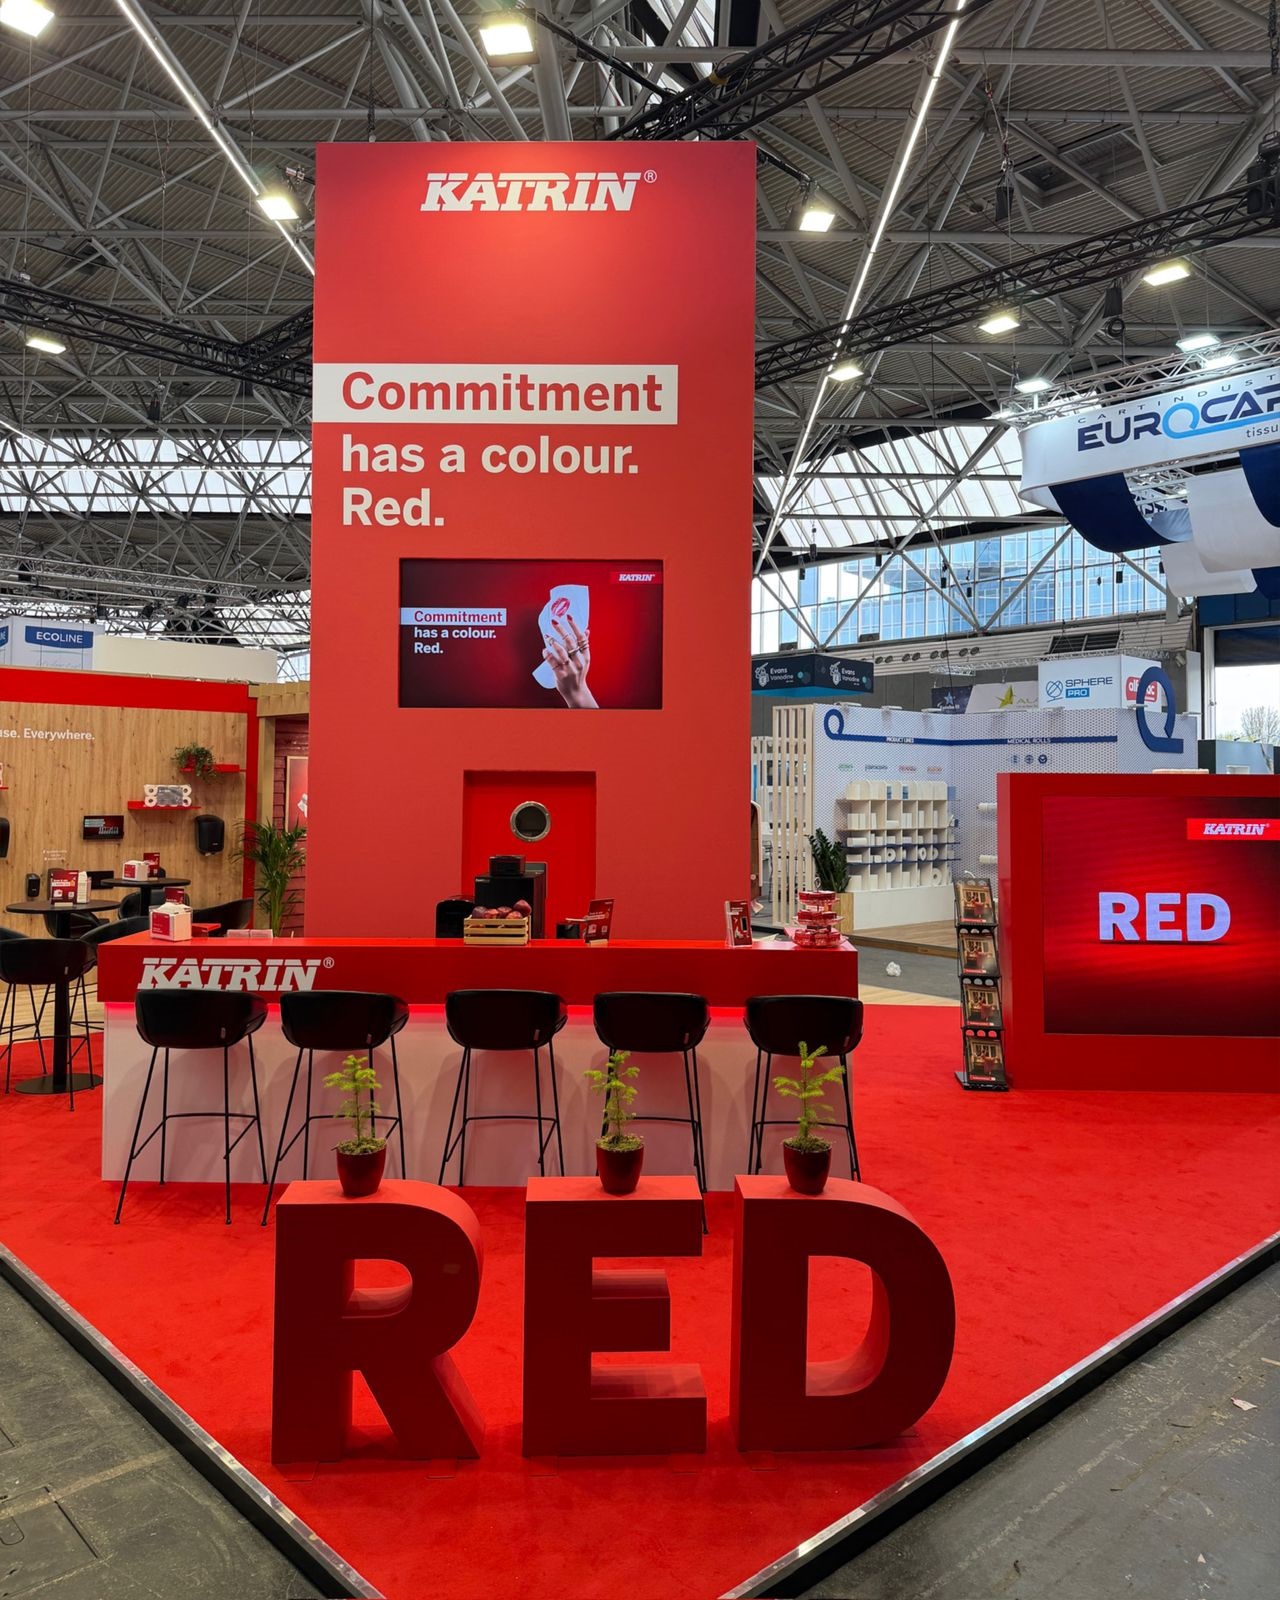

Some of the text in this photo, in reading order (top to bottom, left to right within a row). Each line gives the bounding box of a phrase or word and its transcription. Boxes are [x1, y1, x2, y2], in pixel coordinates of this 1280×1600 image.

[342, 371, 663, 412] Commitment
[342, 434, 639, 474] has a colour.
[342, 487, 445, 527] Red.
[414, 610, 503, 623] Commitment
[36, 631, 84, 644] ECOLINE
[414, 627, 497, 639] has a colour.
[414, 642, 444, 654] Red.
[770, 667, 788, 675] Evans
[841, 667, 856, 676] Evans
[1065, 676, 1113, 688] SPHERE
[1067, 689, 1088, 697] PRO
[23, 728, 95, 741] Everywhere.
[1098, 891, 1231, 942] RED
[271, 1176, 957, 1465] RED
